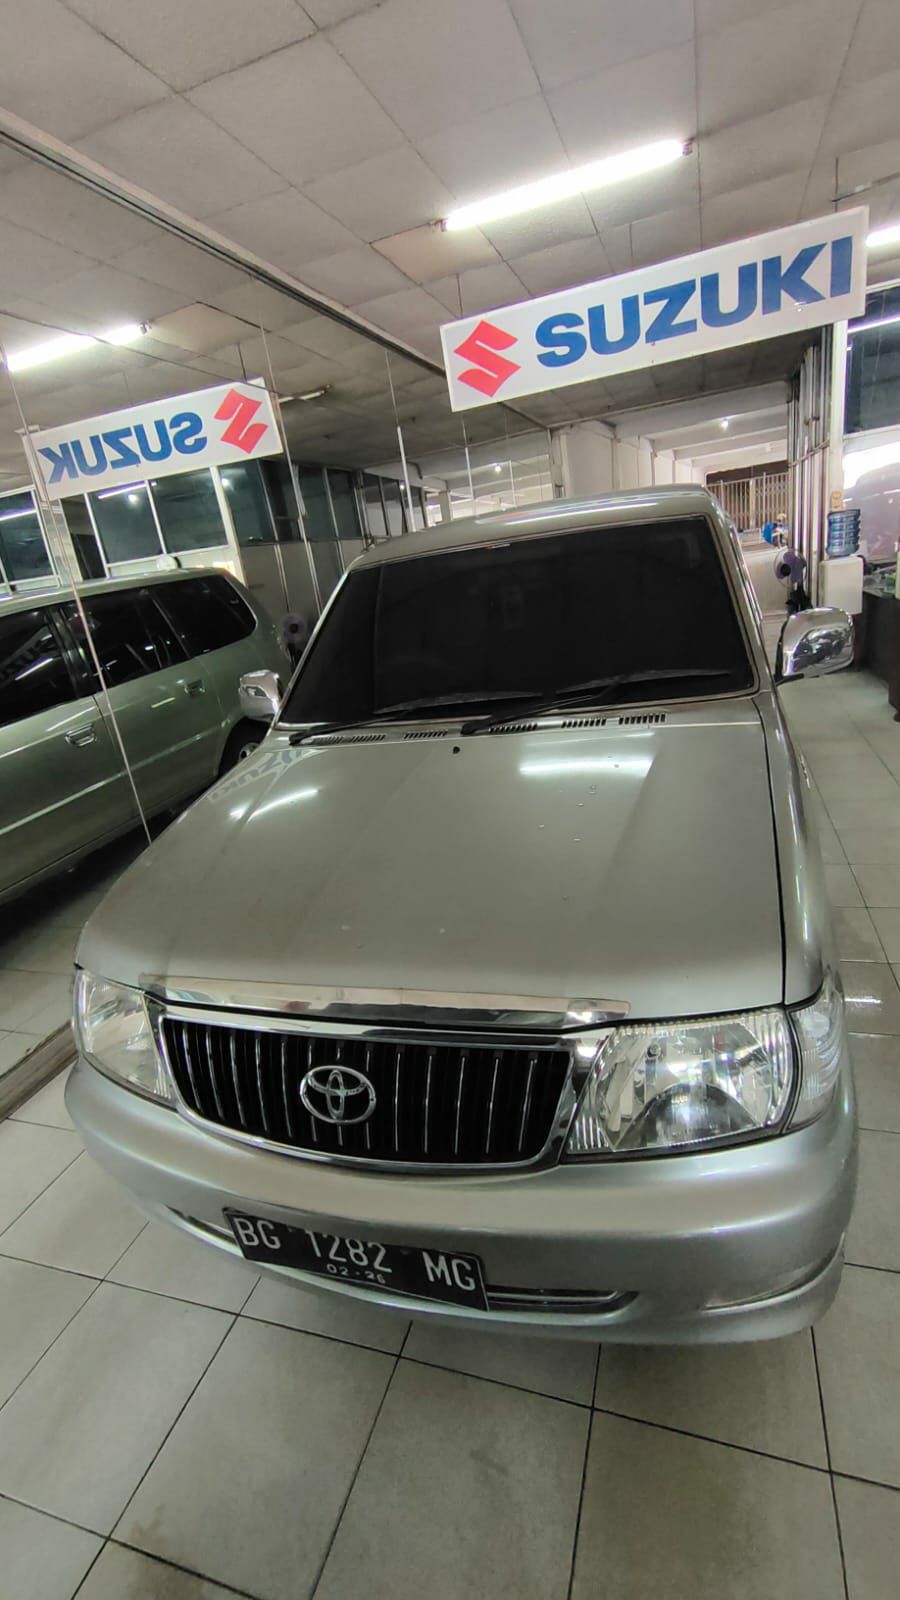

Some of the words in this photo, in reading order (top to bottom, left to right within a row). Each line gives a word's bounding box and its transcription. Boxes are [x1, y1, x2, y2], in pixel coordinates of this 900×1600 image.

[535, 236, 853, 368] SUZUKI
[233, 1217, 281, 1250] BG
[304, 1230, 393, 1273] 1282
[422, 1251, 477, 1291] MG
